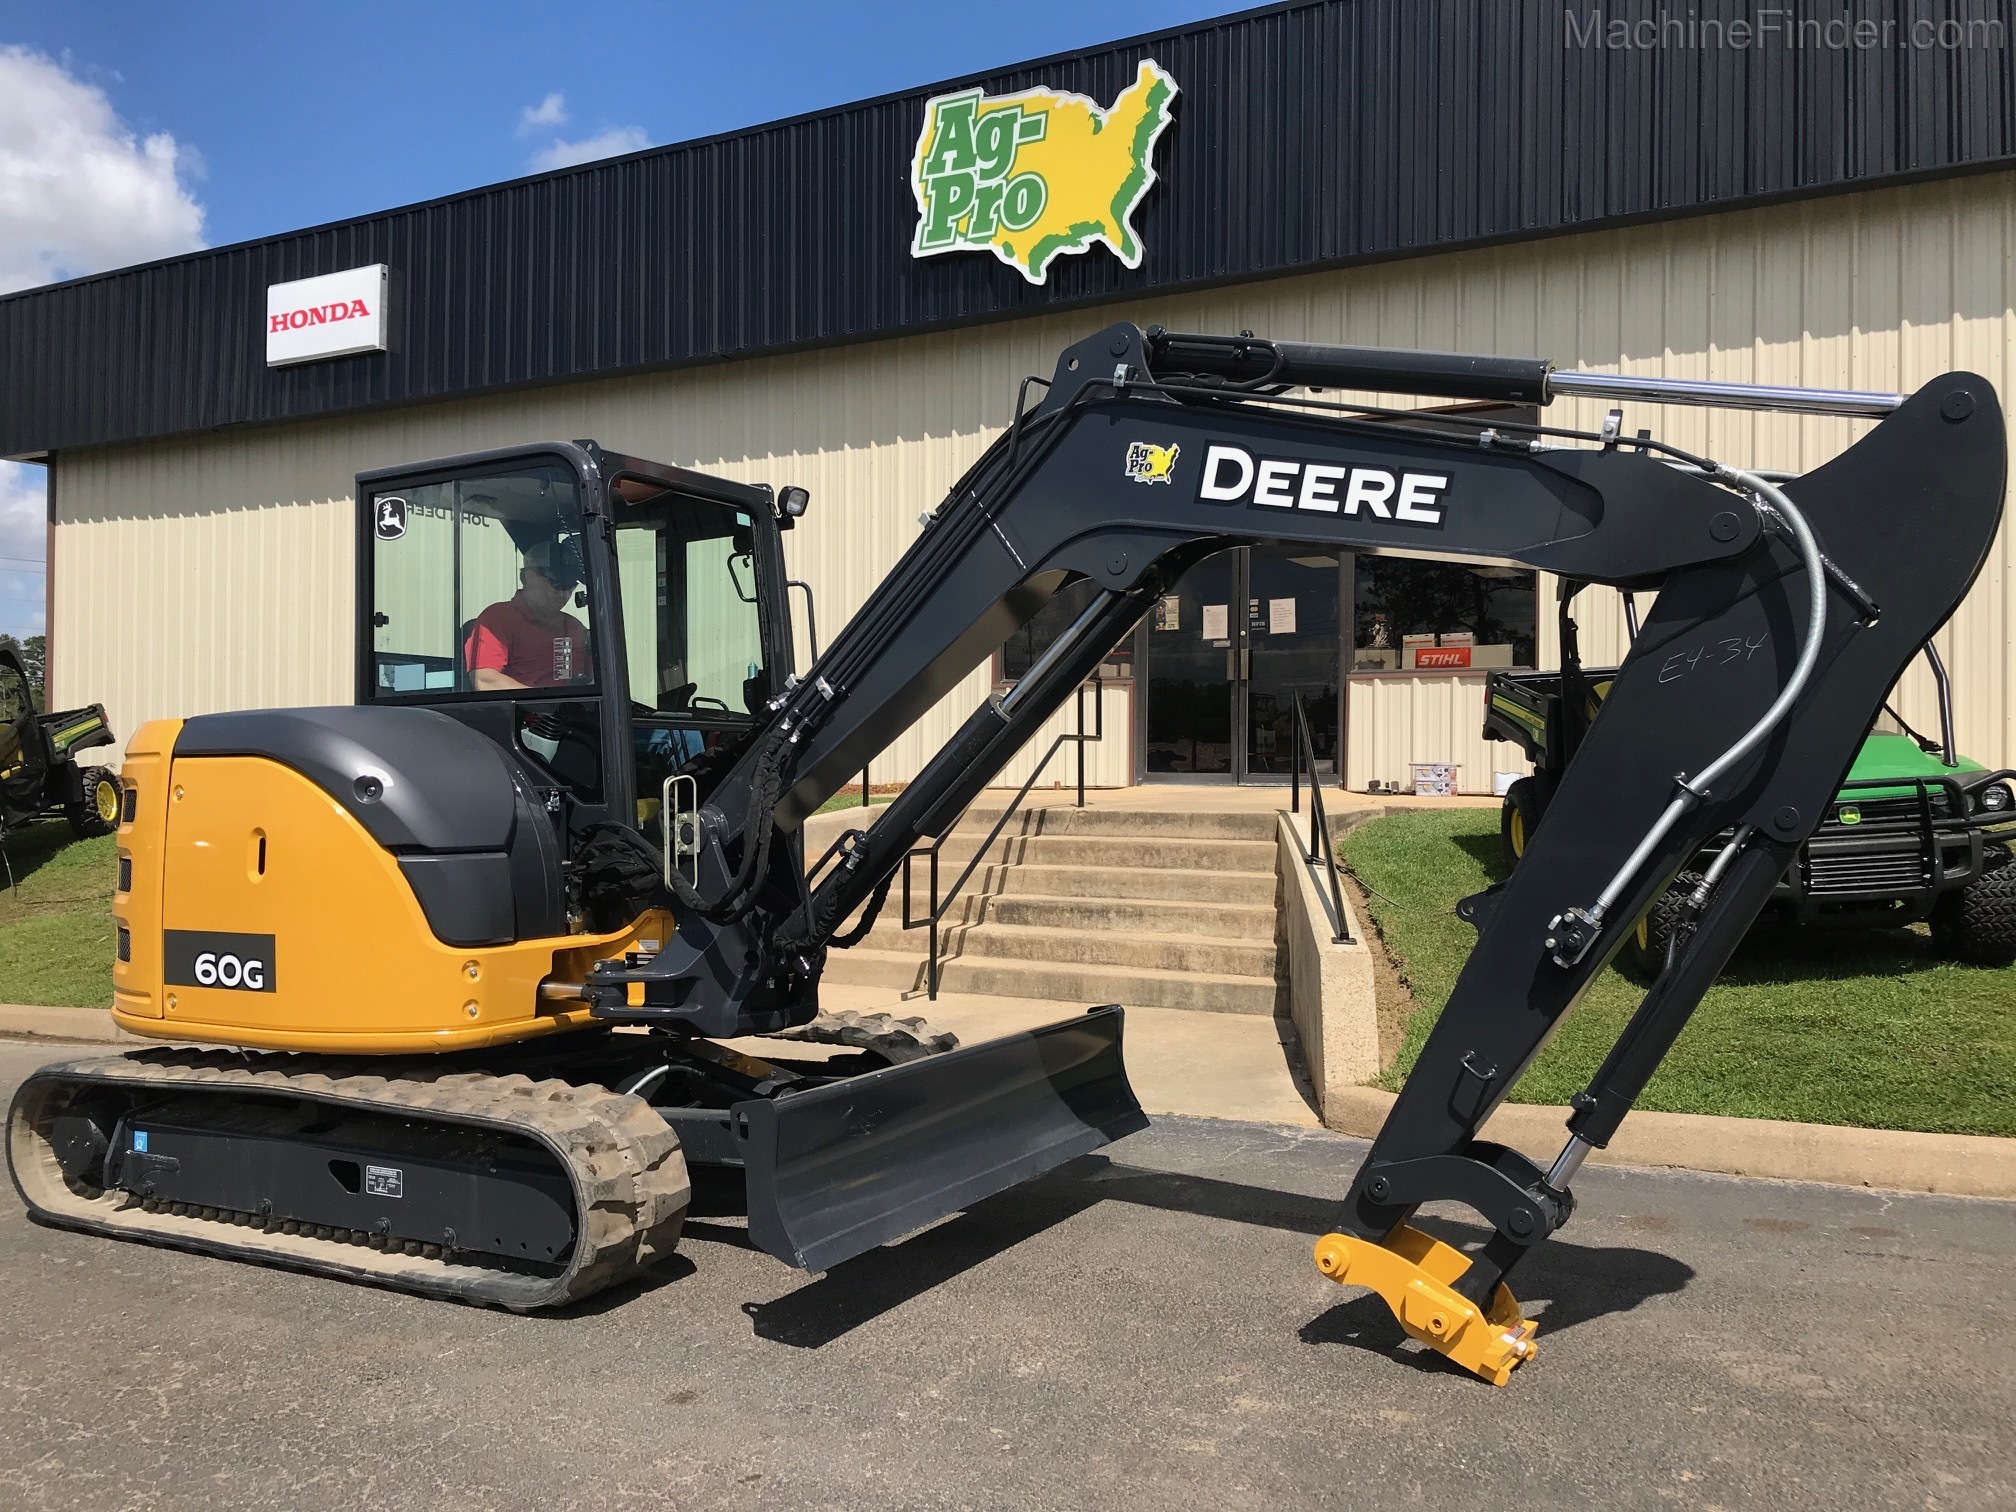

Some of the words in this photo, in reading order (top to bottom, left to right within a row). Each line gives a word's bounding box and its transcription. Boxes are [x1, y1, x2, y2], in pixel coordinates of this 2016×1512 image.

[923, 100, 1047, 184] Ag-
[922, 170, 1047, 247] Pro
[269, 298, 371, 334] HONDA
[1128, 459, 1153, 473] Pro
[1130, 445, 1154, 462] Ag-
[1199, 445, 1448, 524] DEERE
[1418, 653, 1464, 666] STIHL
[194, 952, 264, 990] 60G
